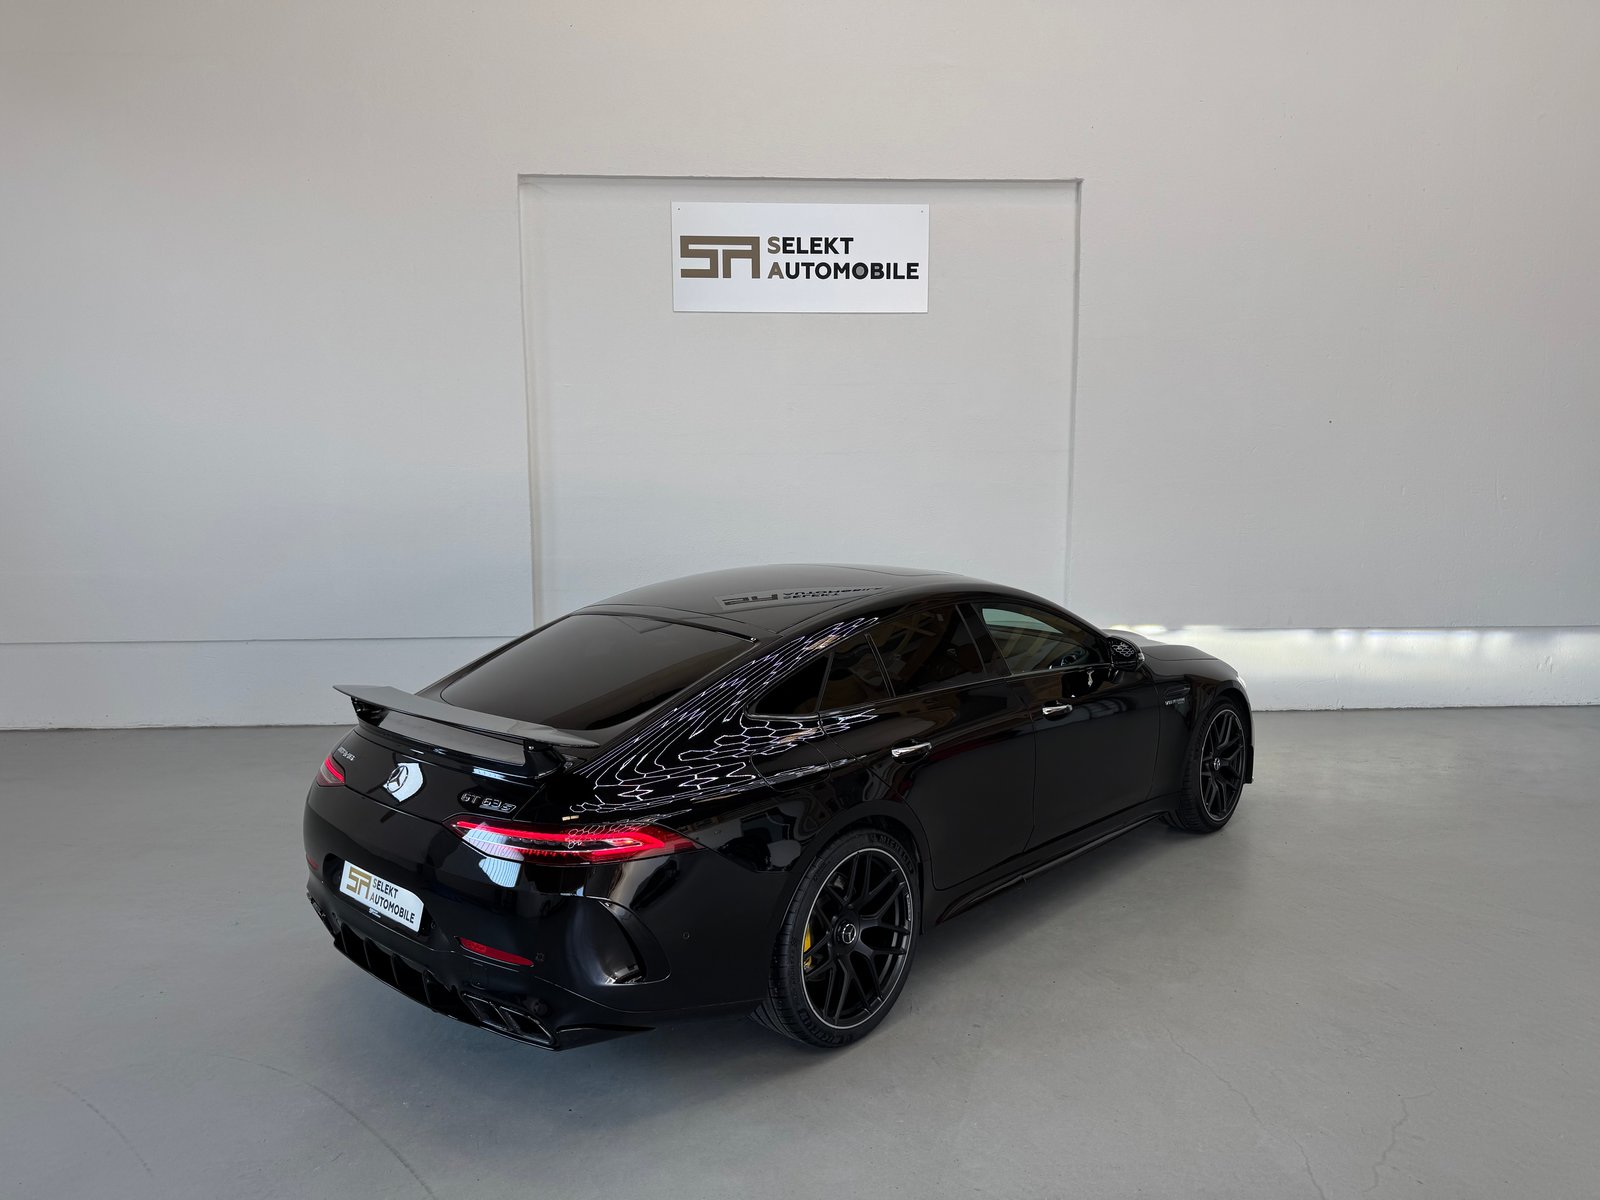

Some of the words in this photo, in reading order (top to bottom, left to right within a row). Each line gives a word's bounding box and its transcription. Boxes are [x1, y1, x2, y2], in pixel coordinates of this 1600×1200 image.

[767, 236, 854, 255] SELEKT
[680, 235, 761, 279] SA
[767, 262, 920, 280] AUTOMOBILE
[460, 792, 481, 804] GT
[346, 866, 373, 900] SA
[372, 877, 399, 899] SELEKT
[369, 892, 416, 924] AUTOMOBILE
